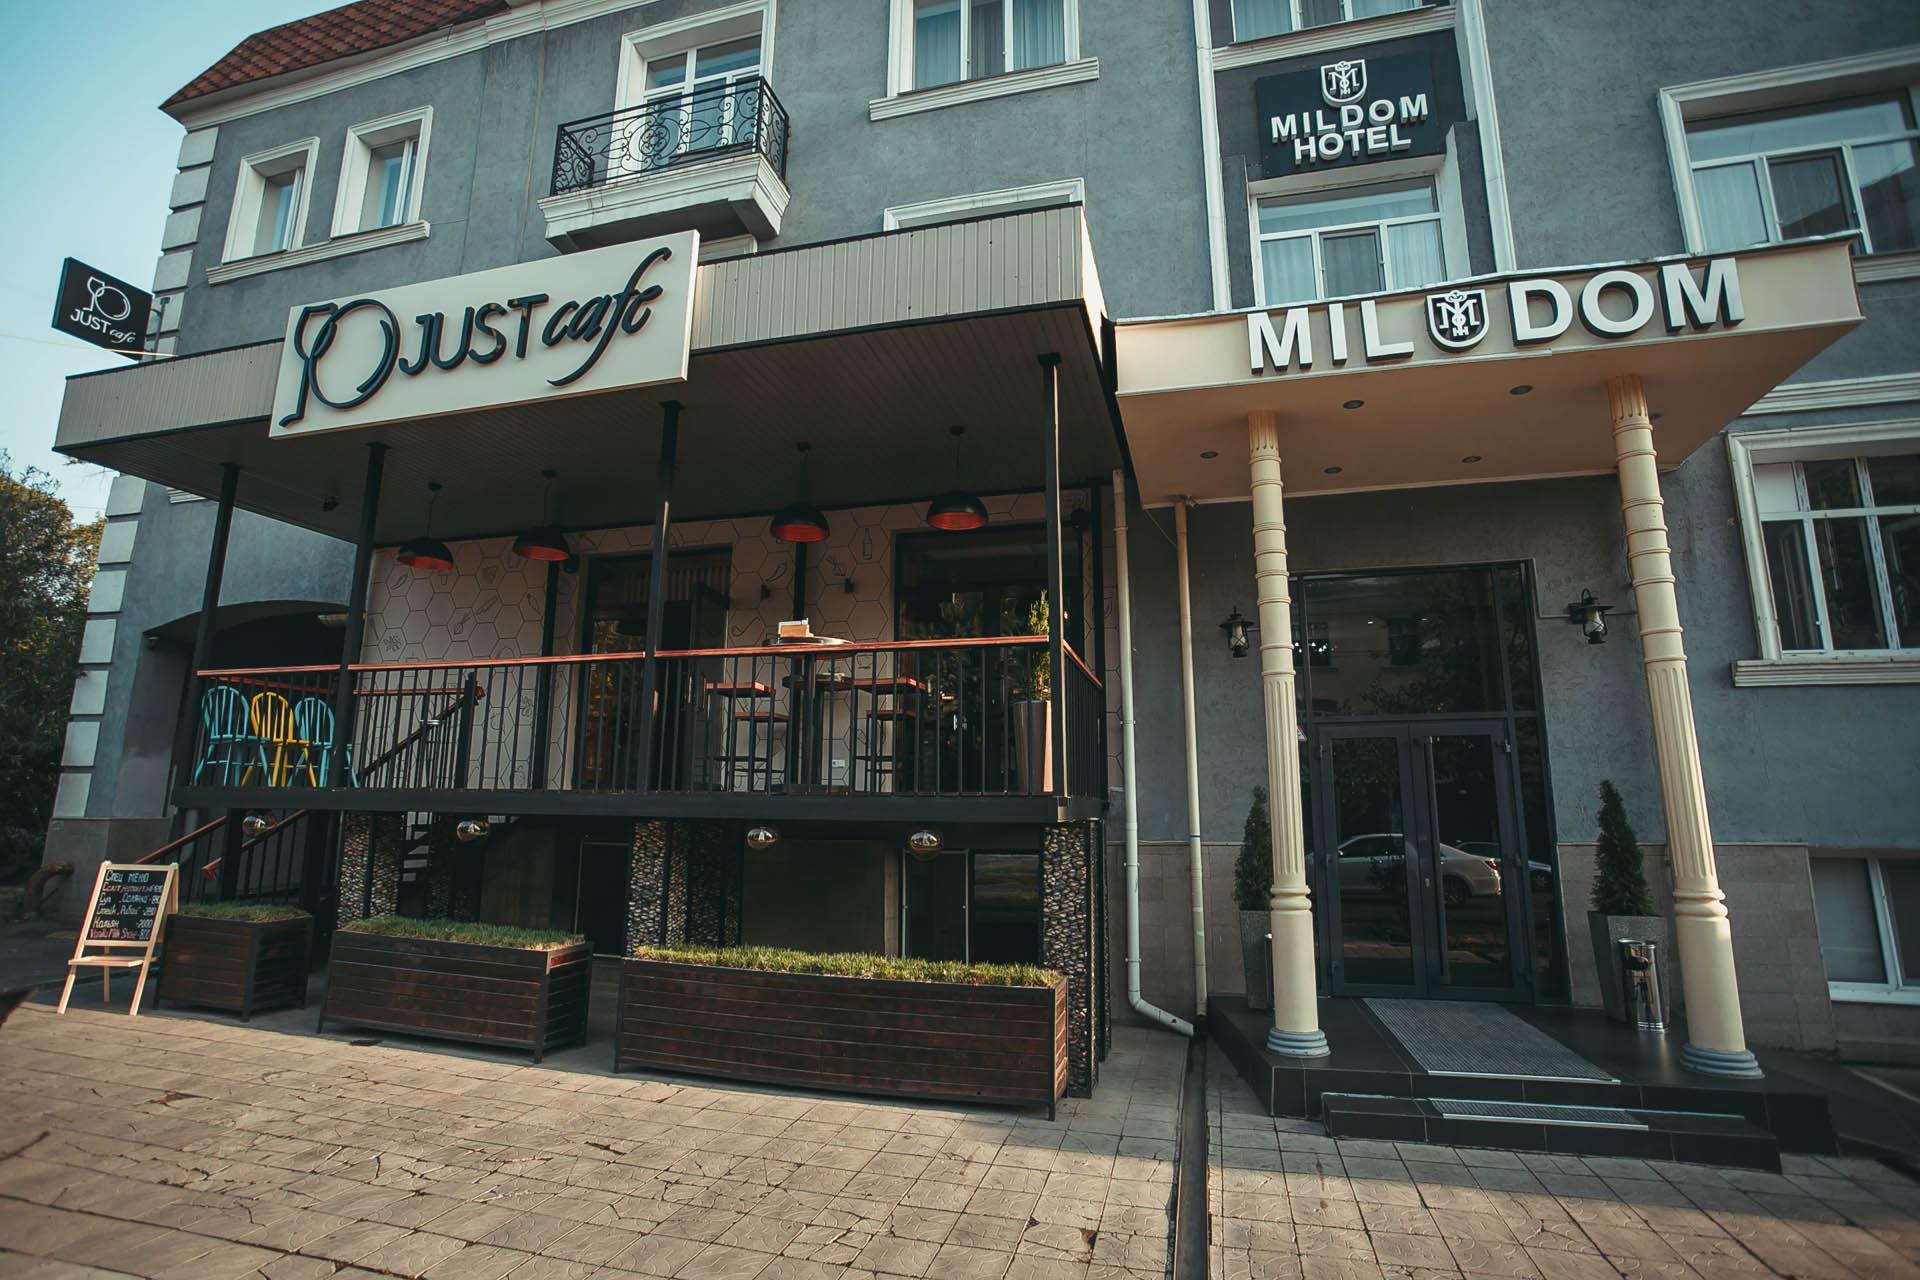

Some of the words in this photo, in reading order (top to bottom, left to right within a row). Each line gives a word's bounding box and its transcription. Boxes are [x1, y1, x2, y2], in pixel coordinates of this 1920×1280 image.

[1271, 93, 1429, 143] MILDOM
[1294, 124, 1411, 165] HOTEL
[70, 308, 111, 333] JUST
[109, 329, 136, 344] cafe
[399, 292, 550, 376] JUST
[541, 246, 672, 386] cafe
[1247, 300, 1415, 374] MIL
[1507, 257, 1745, 345] DOM
